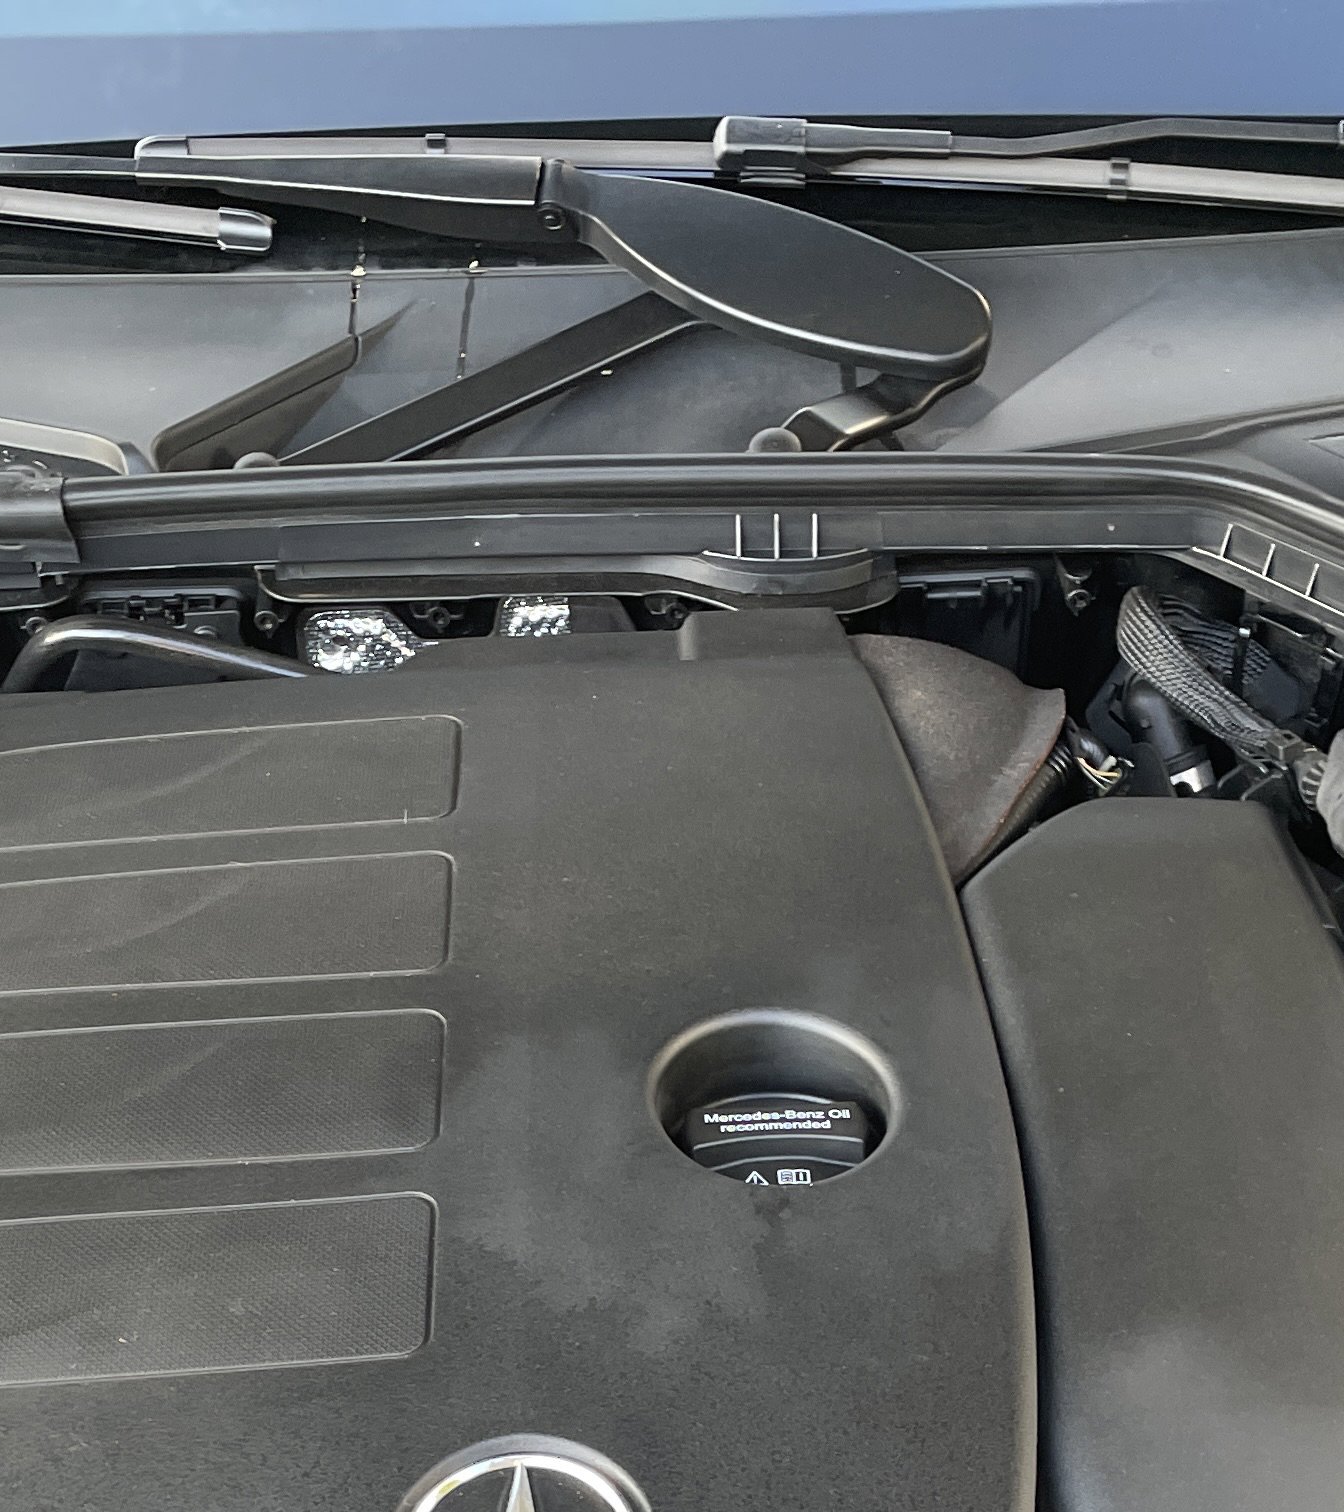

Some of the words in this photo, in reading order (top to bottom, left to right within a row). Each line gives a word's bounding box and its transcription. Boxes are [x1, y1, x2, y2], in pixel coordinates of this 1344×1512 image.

[703, 1110, 825, 1124] Mercedes-Benz
[827, 1108, 851, 1119] Oil
[719, 1119, 832, 1133] recommended
